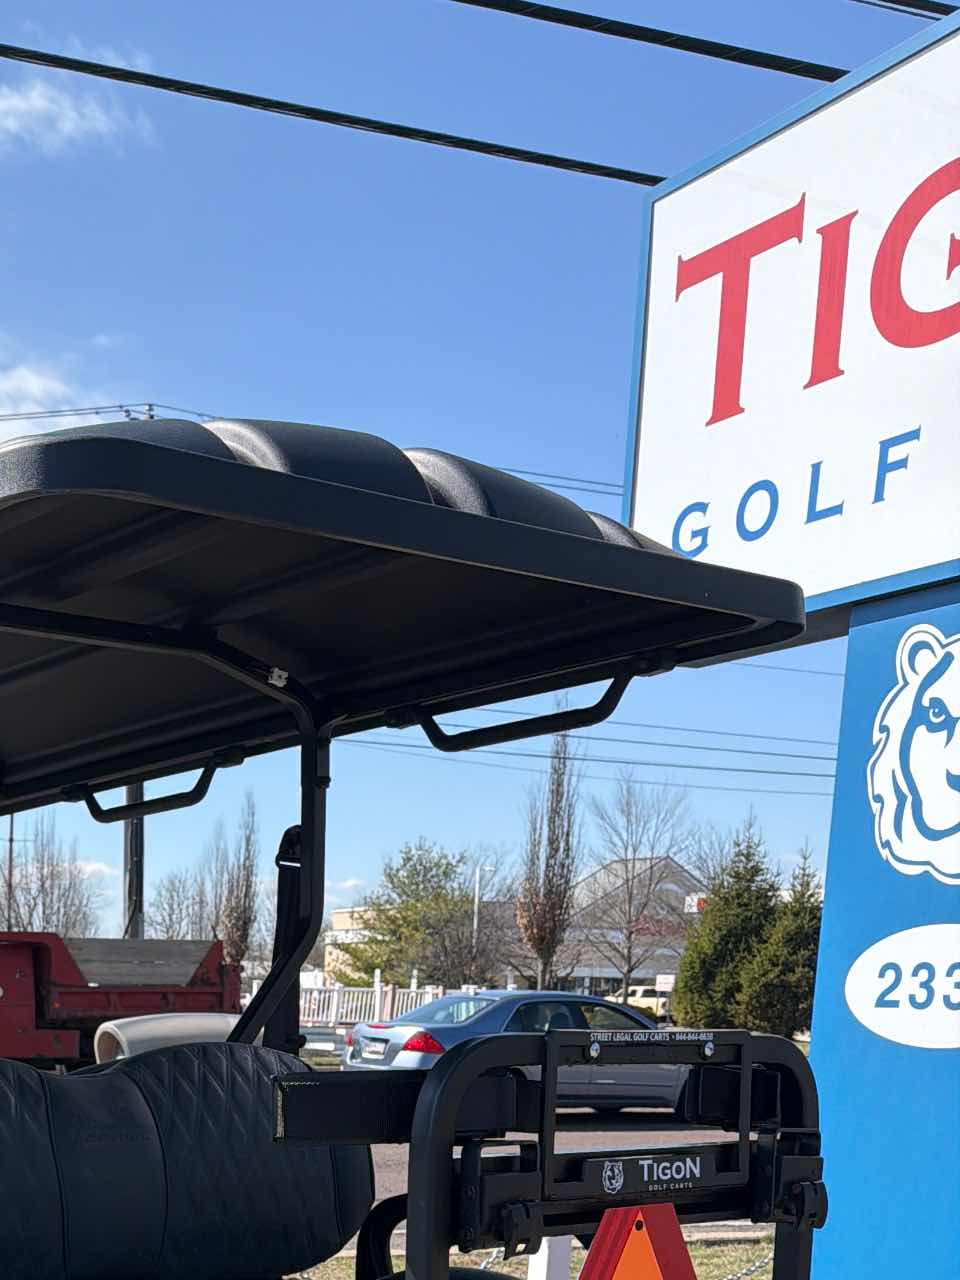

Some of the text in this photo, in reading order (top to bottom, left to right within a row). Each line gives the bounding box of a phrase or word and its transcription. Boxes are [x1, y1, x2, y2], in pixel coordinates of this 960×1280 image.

[671, 425, 921, 559] GOLF
[590, 1032, 612, 1041] STREET
[613, 1032, 633, 1041] LEGAL
[633, 1032, 650, 1041] GOLF
[651, 1032, 670, 1041] CARTS
[639, 1157, 701, 1182] TIGON
[648, 1182, 693, 1191] GOLF CARTS
